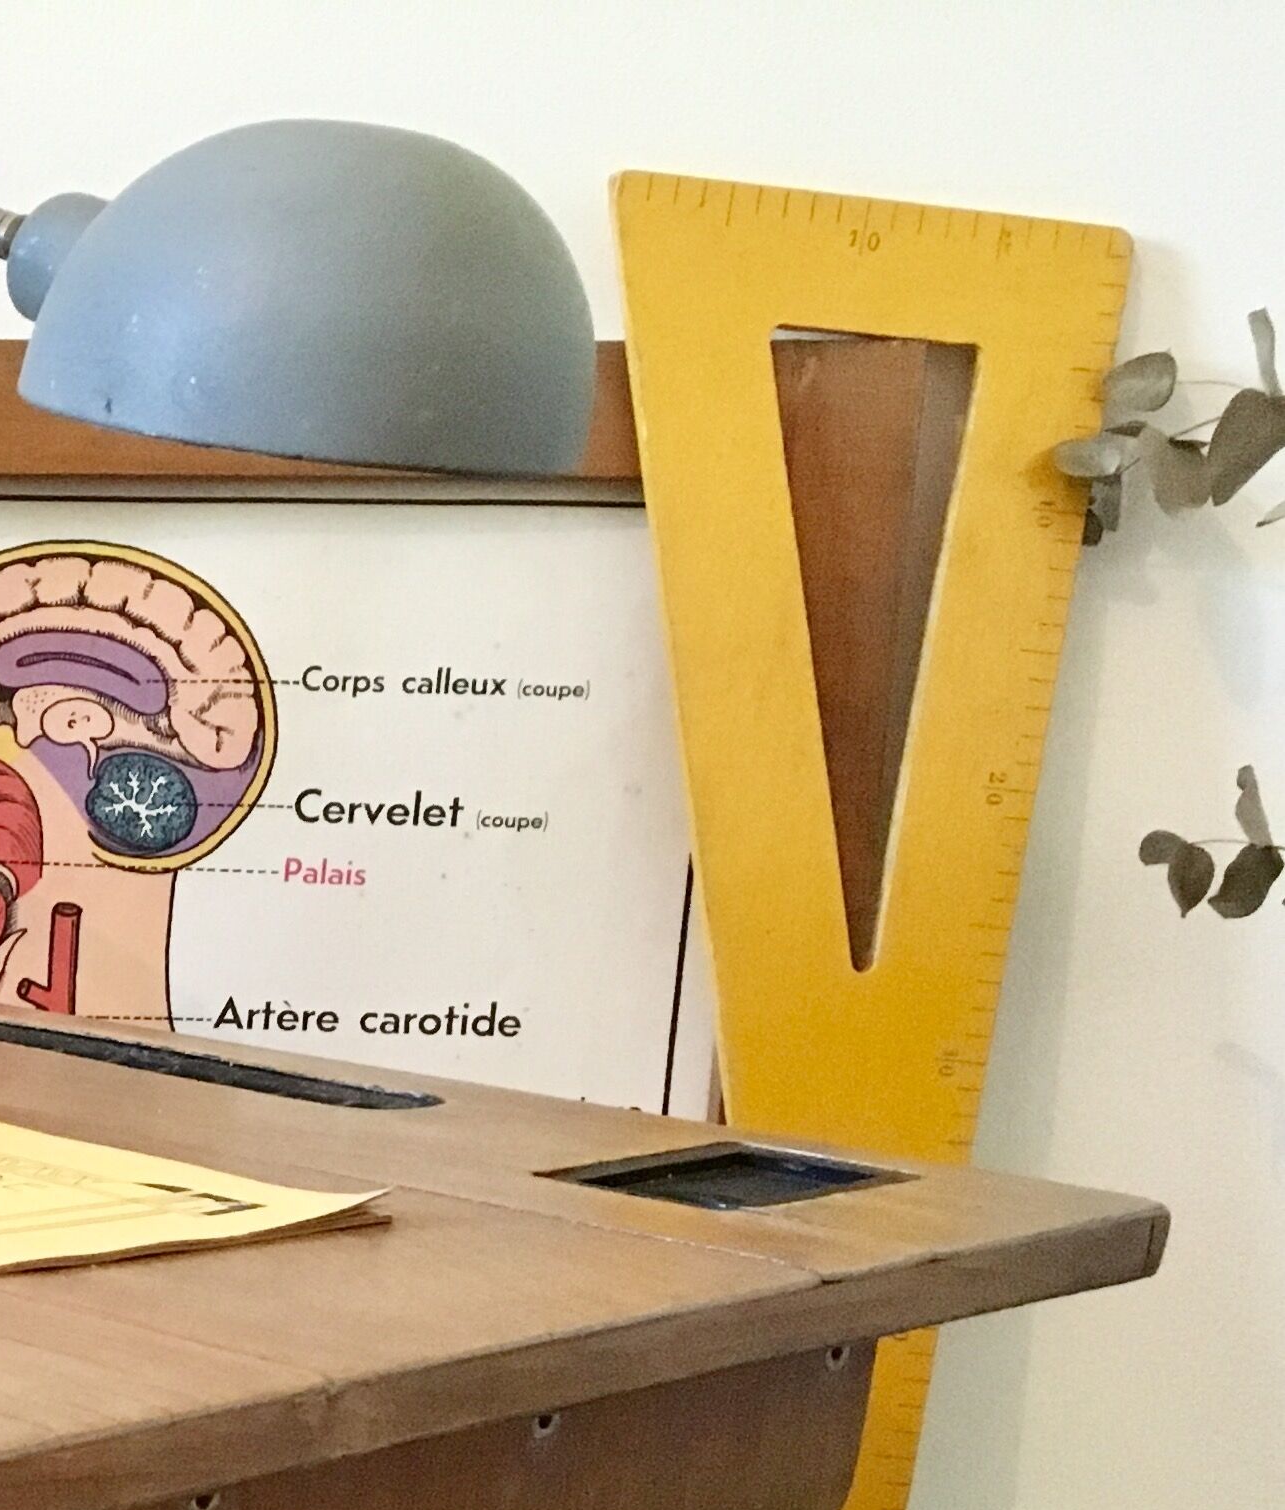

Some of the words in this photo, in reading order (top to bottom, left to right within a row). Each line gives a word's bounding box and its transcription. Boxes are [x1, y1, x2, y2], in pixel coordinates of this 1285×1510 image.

[847, 228, 881, 252] 10
[301, 665, 385, 698] Corps
[401, 666, 507, 696] calleux
[517, 681, 590, 701] (coupe)
[984, 770, 1008, 807] 20
[295, 788, 465, 828] Cervelet
[476, 811, 549, 833] (coupe)
[283, 857, 366, 886] Palais
[213, 993, 340, 1033] Artère
[359, 1003, 522, 1038] carotide
